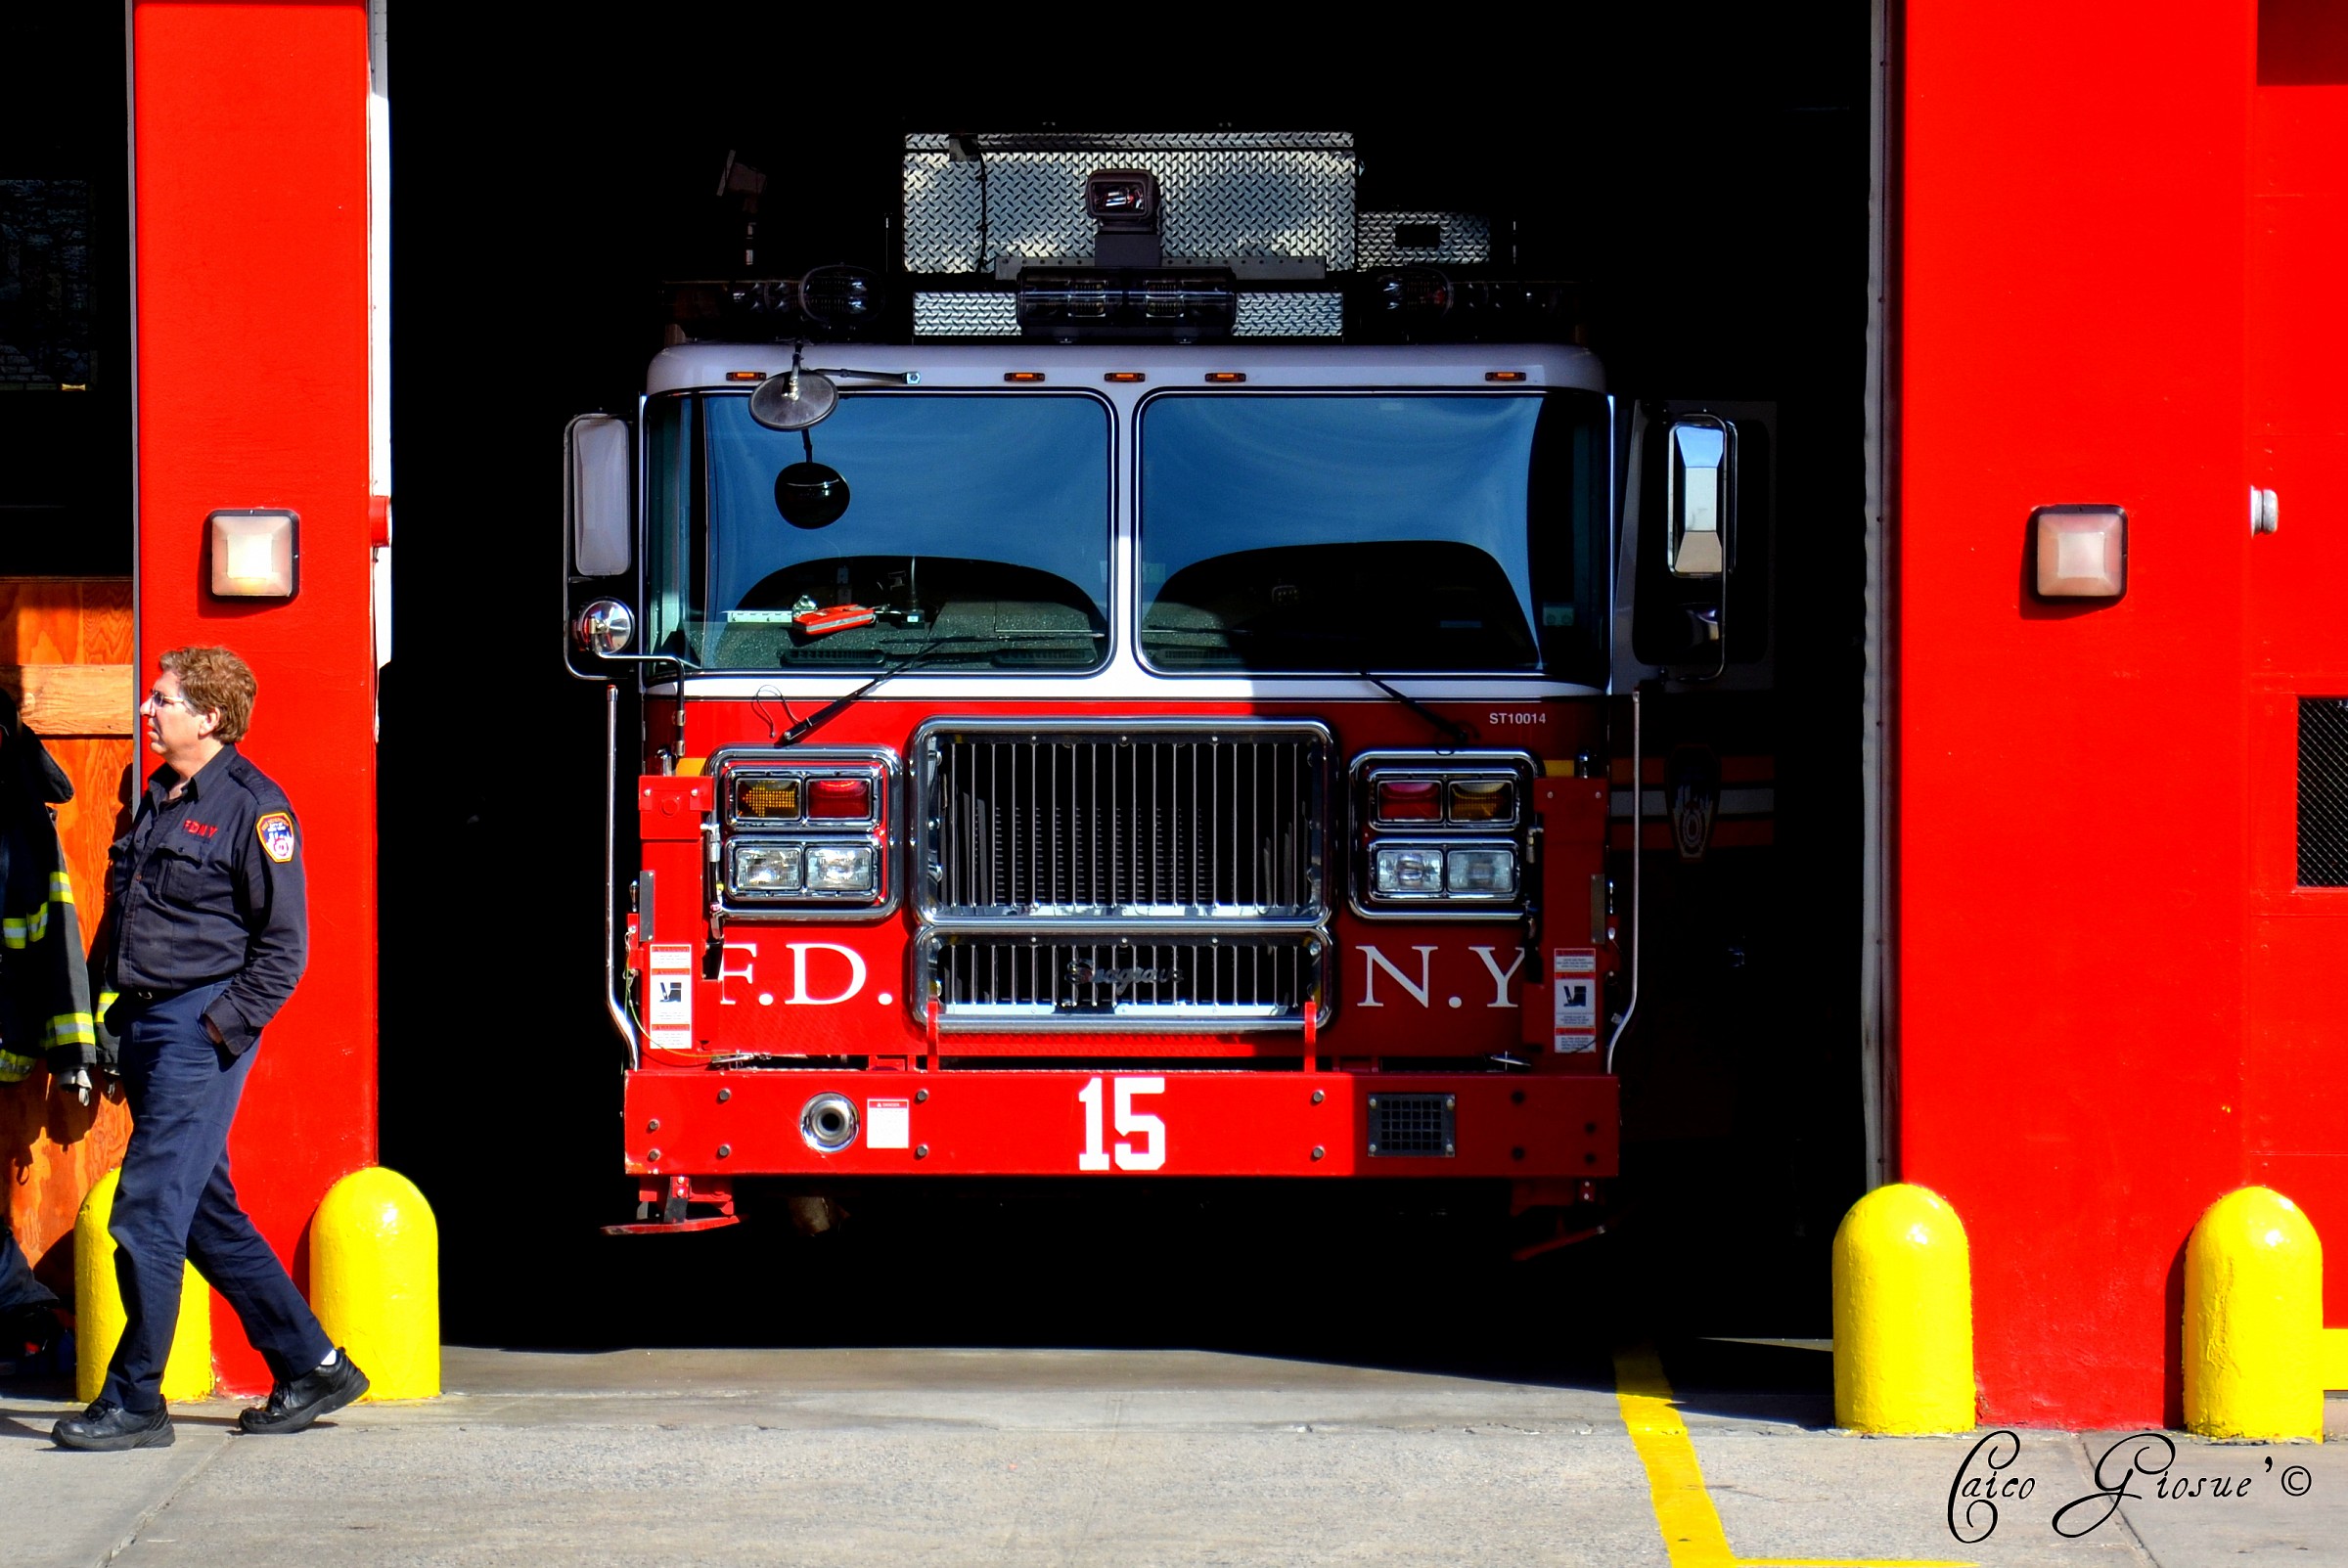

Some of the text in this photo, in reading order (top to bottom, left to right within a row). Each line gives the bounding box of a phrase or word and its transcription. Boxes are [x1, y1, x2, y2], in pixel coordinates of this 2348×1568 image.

[1489, 712, 1547, 725] ST10014
[718, 943, 893, 1006] F.D.
[1078, 1077, 1166, 1171] 15
